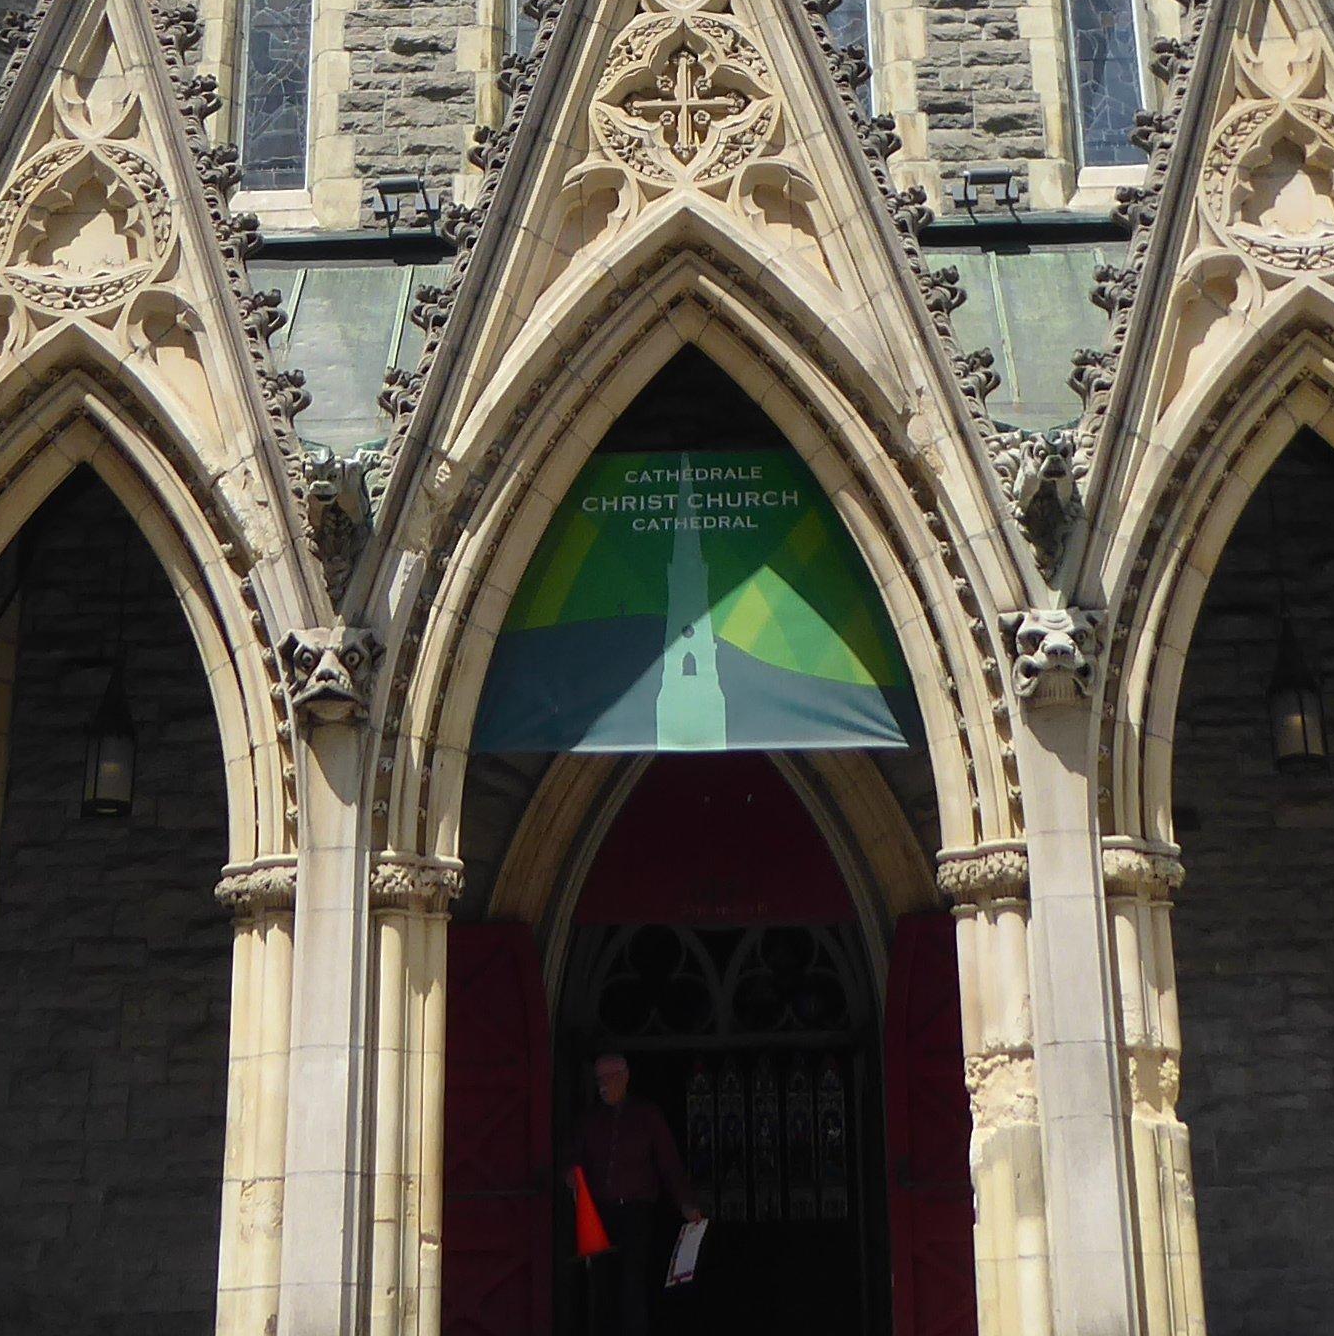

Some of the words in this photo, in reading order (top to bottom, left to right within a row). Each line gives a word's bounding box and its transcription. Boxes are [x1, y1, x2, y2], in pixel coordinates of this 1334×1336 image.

[582, 493, 679, 512] CHRIST
[687, 490, 799, 510] CHURCH
[632, 515, 758, 531] CATHEDRAL
